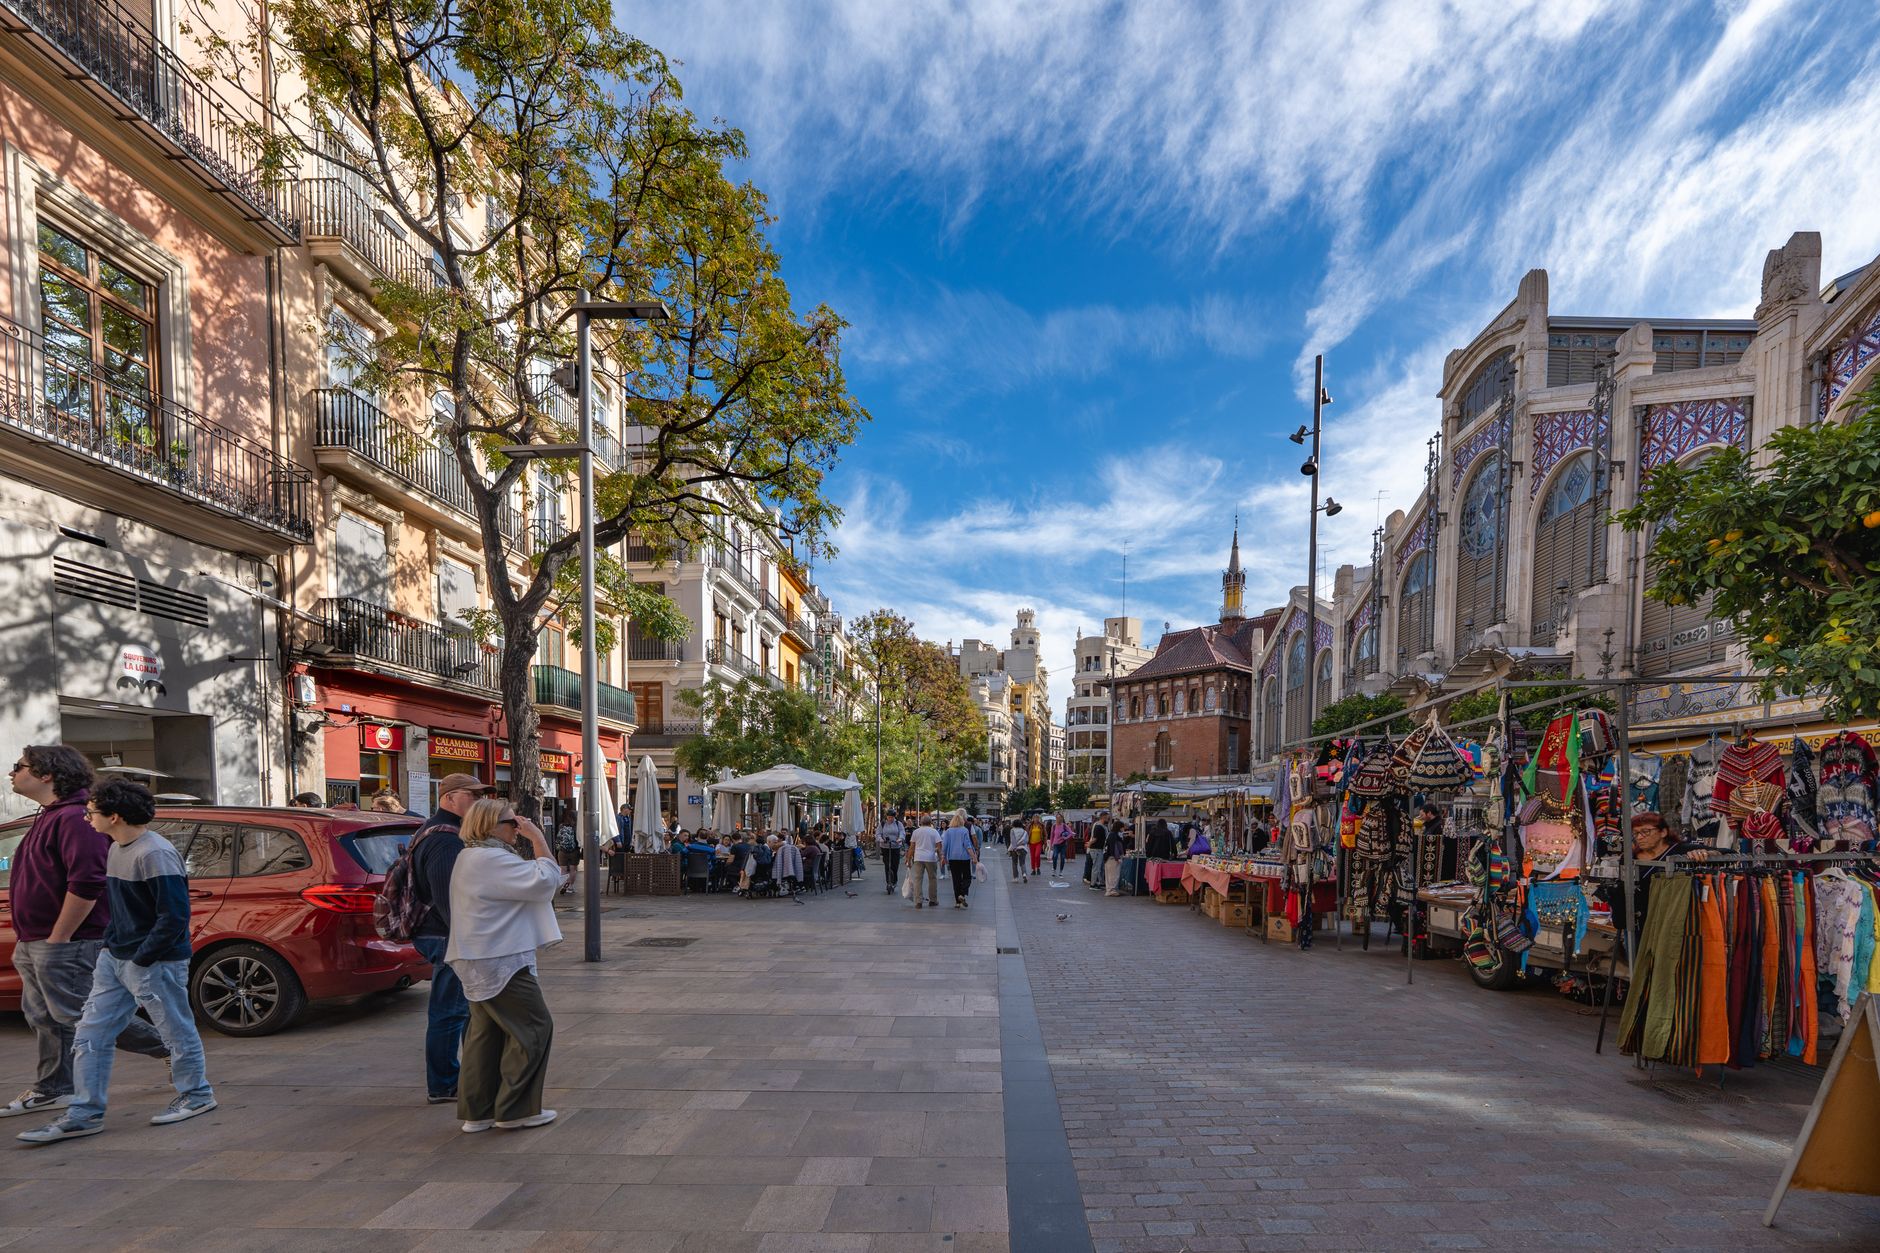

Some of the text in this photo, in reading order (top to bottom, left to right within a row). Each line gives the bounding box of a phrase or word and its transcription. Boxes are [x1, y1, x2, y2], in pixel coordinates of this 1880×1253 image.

[124, 662, 158, 674] LA LONJA
[824, 635, 832, 701] FARMACIA
[435, 736, 479, 750] CALAMARES
[1778, 737, 1820, 752] PAEAS
[435, 745, 479, 758] PESCADITOS
